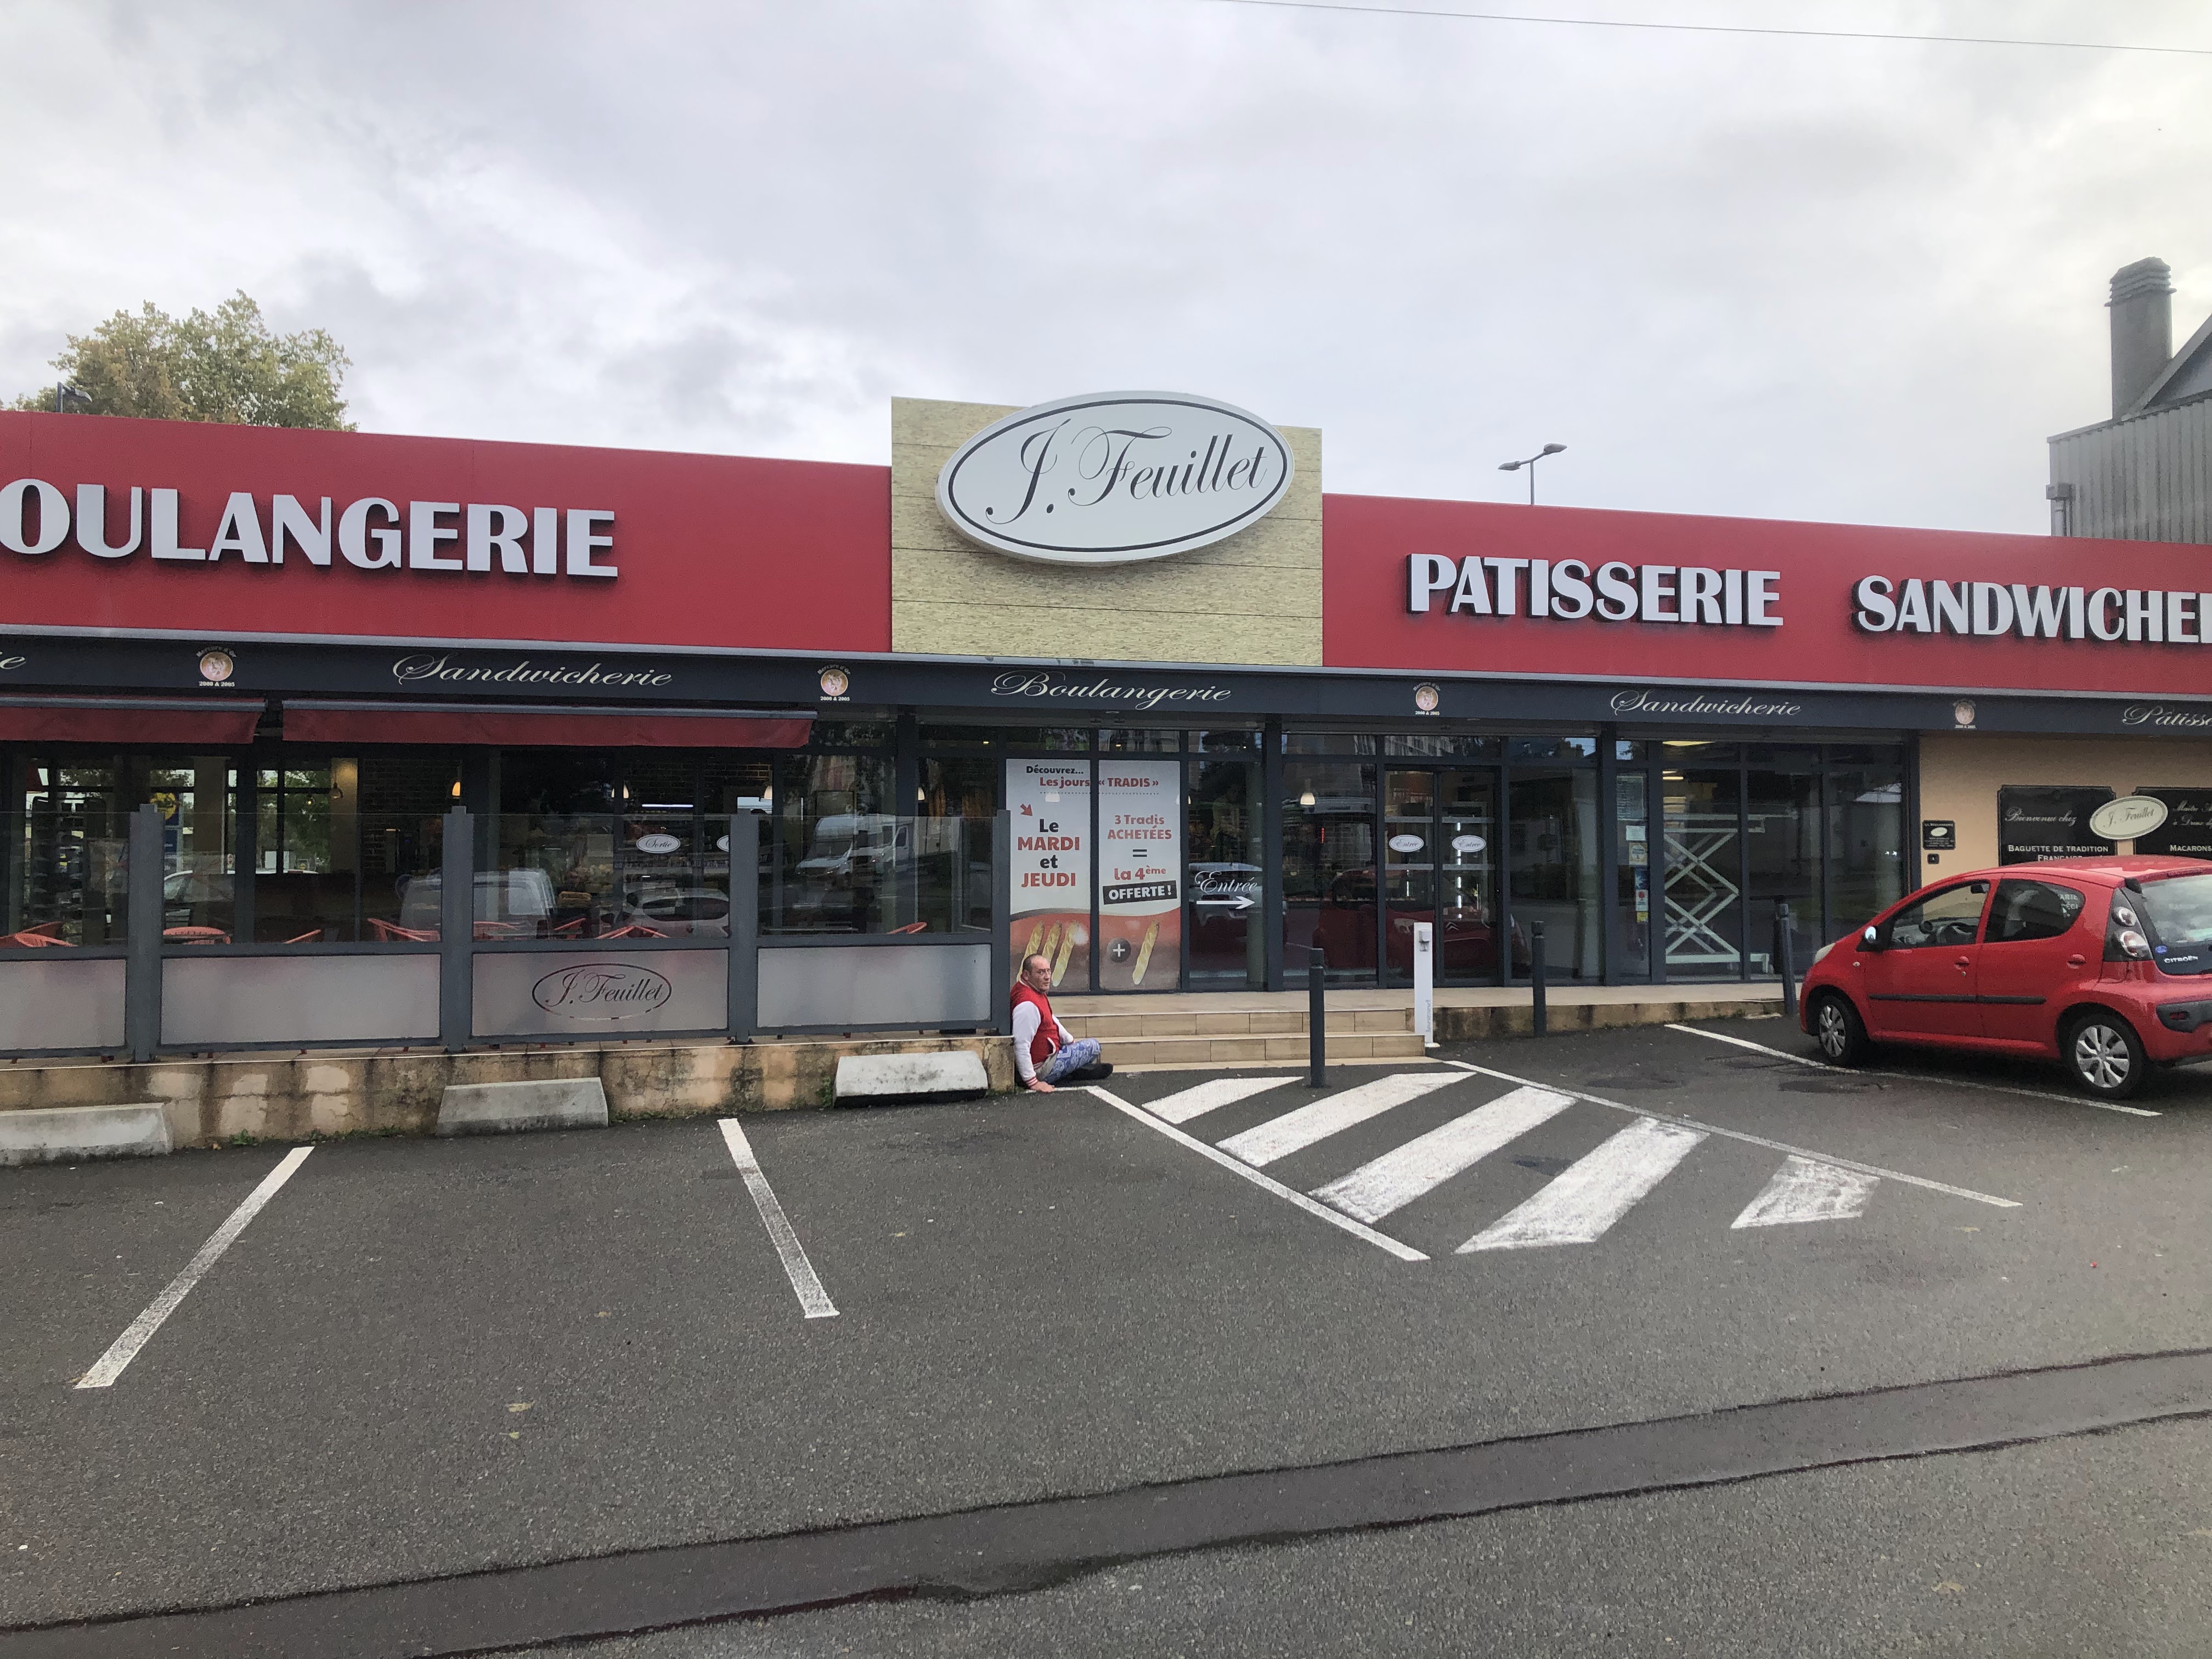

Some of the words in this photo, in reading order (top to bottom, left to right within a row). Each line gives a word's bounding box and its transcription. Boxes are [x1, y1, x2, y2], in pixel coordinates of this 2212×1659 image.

[986, 418, 1071, 524] J.
[1068, 426, 1267, 506] Feuillet
[1409, 553, 1784, 627] PATISSERIE
[393, 653, 672, 686] Sandwicherie
[991, 670, 1232, 710] Boulangerie
[1611, 689, 1802, 716] Sandwicherie
[1026, 764, 1084, 774] Découvrez...
[1040, 777, 1058, 787] Les
[1059, 776, 1090, 788] jours
[1107, 777, 1150, 787] TRADIS
[1114, 815, 1121, 825] 3
[1124, 814, 1165, 825] Tradis
[2058, 809, 2077, 827] chez
[2119, 806, 2155, 822] Feuillet
[1039, 819, 1059, 833] Le
[1107, 825, 1172, 840] ACHETÉES
[646, 838, 672, 848] Sortie
[1018, 837, 1080, 850] MARDI
[1040, 854, 1058, 868] et
[1021, 872, 1076, 887] JEUDI
[1114, 868, 1131, 881] la
[1135, 865, 1166, 881] 4ème
[1195, 871, 1257, 894] Entrée
[1108, 885, 1165, 900] OFFERTE
[2164, 955, 2198, 963] CITROËN
[545, 969, 585, 1007] J.
[579, 972, 663, 1003] Feuillet
